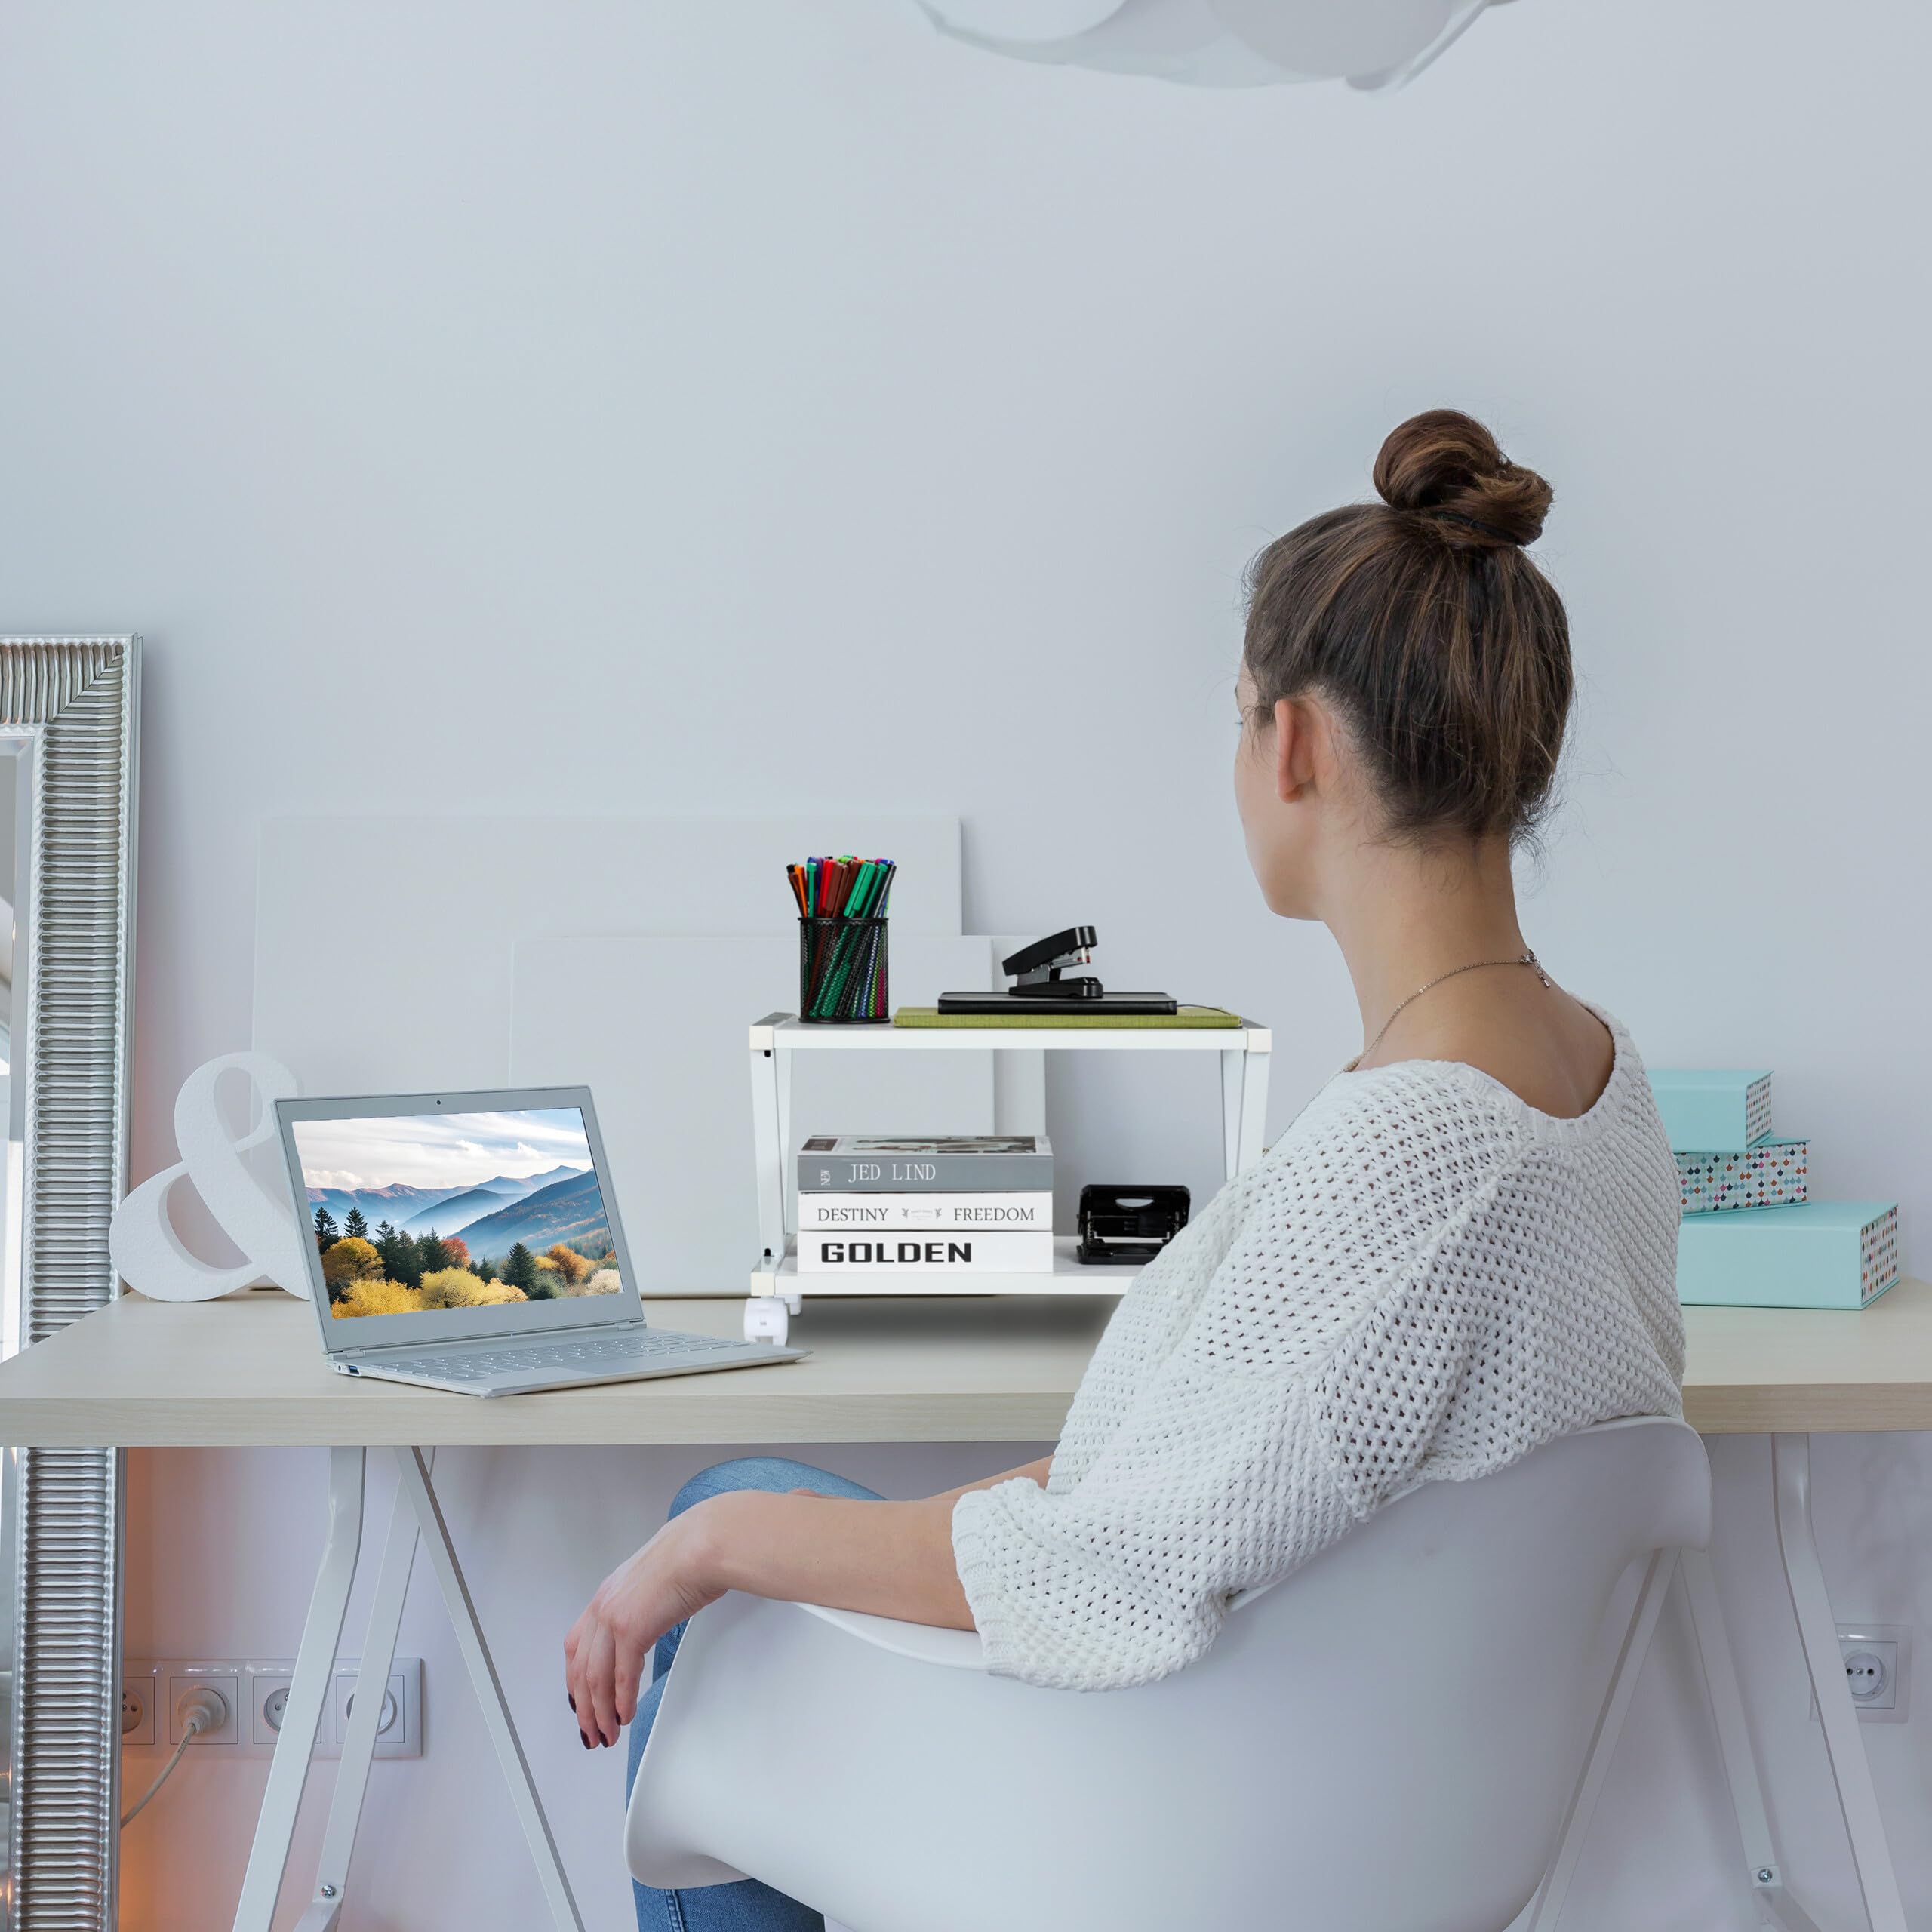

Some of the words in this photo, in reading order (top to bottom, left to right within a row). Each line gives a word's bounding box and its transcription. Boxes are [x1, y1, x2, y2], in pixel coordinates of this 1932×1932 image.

[848, 1164, 881, 1183] JED
[892, 1164, 937, 1180] LIND
[817, 1208, 888, 1222] DESTINY
[954, 1208, 1035, 1221] FREEDOM
[820, 1242, 972, 1263] GOLDEN
